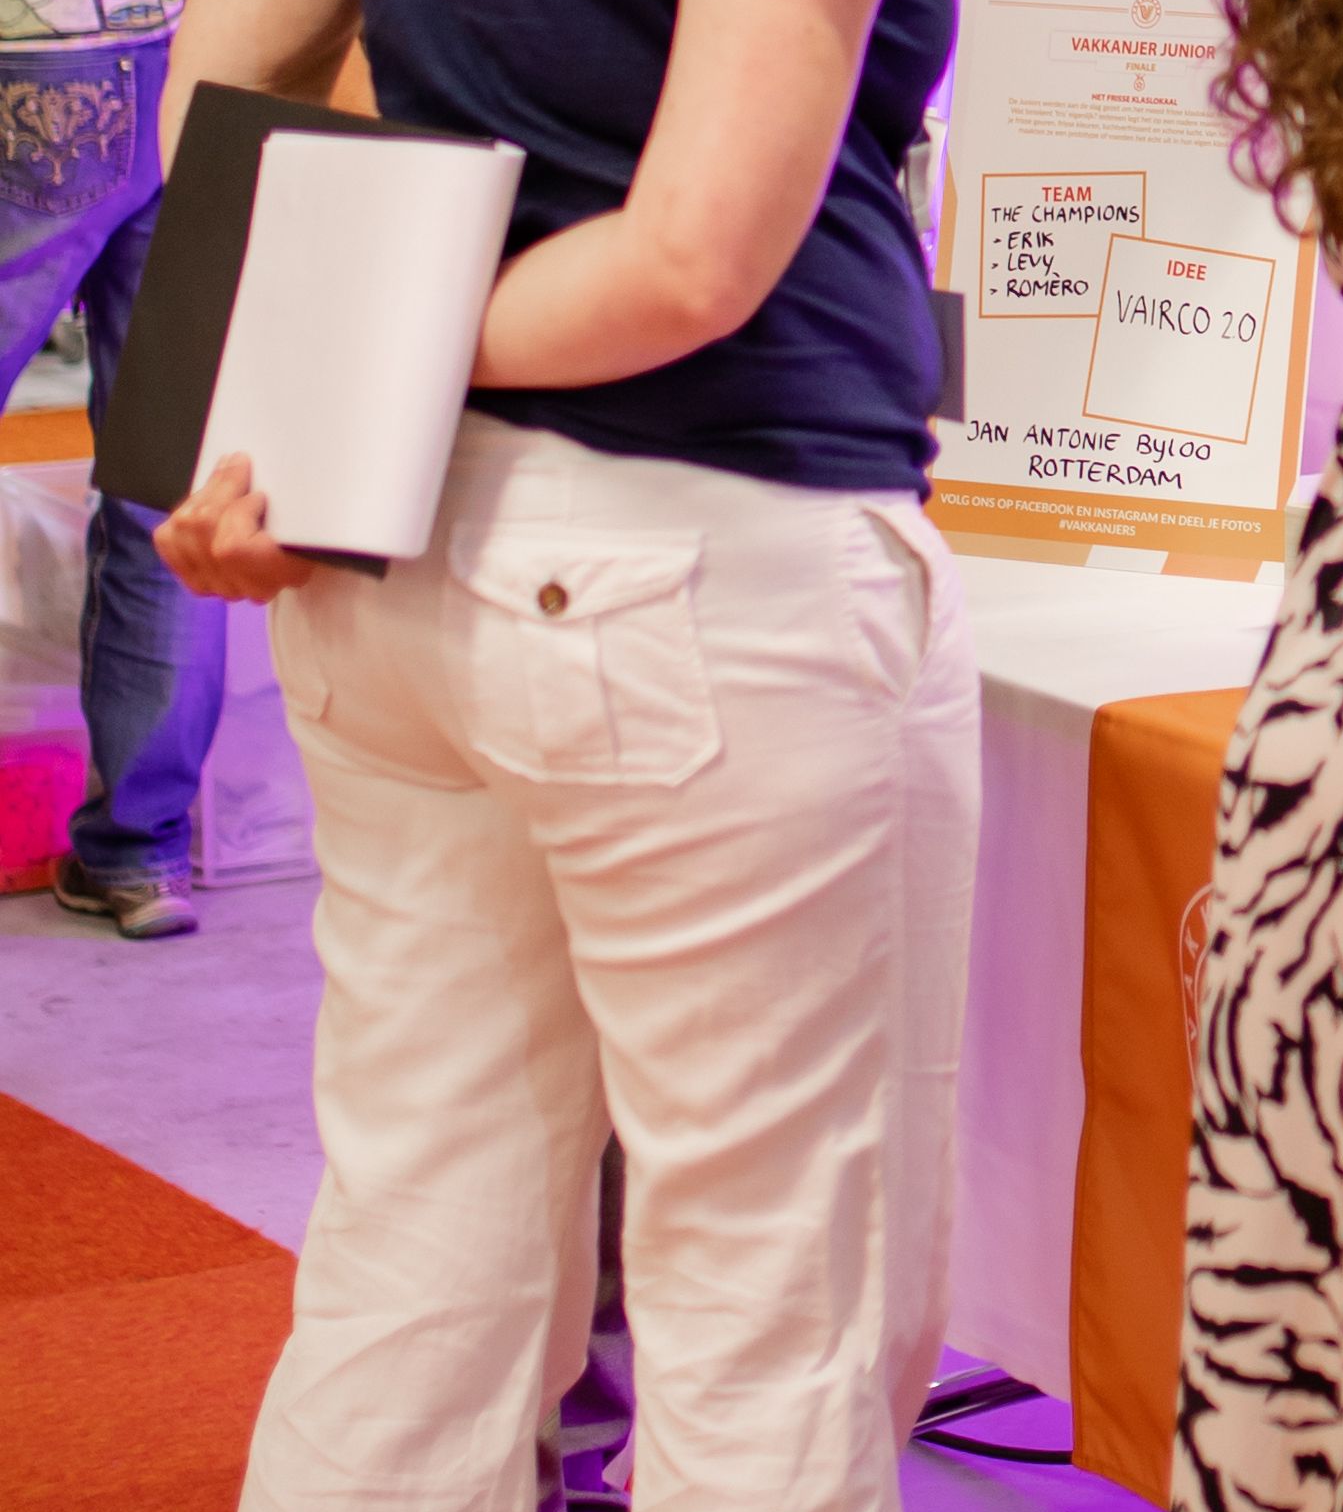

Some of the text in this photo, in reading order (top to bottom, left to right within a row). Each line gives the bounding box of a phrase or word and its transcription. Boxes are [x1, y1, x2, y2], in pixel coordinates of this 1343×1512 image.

[1071, 37, 1216, 60] VAKKANJER JUNIOR
[1126, 62, 1157, 72] FINALE
[1107, 94, 1130, 103] FRISSE
[1042, 186, 1092, 202] TEAM
[991, 205, 1140, 224] THE CHAMPIONS
[1007, 231, 1054, 249] ERIK
[1166, 259, 1207, 281] IDEE
[1117, 290, 1211, 335] VAIRCO
[966, 420, 1009, 443] JAN
[1023, 424, 1121, 451] ANTONIE
[1028, 454, 1182, 490] ROTTERDAM
[940, 493, 1262, 534] VOLG ONS OP FACEBOOK EN INSTAGRAM EN DEEL JE FOTO'S
[1059, 519, 1136, 536] #VAKKANJERS
